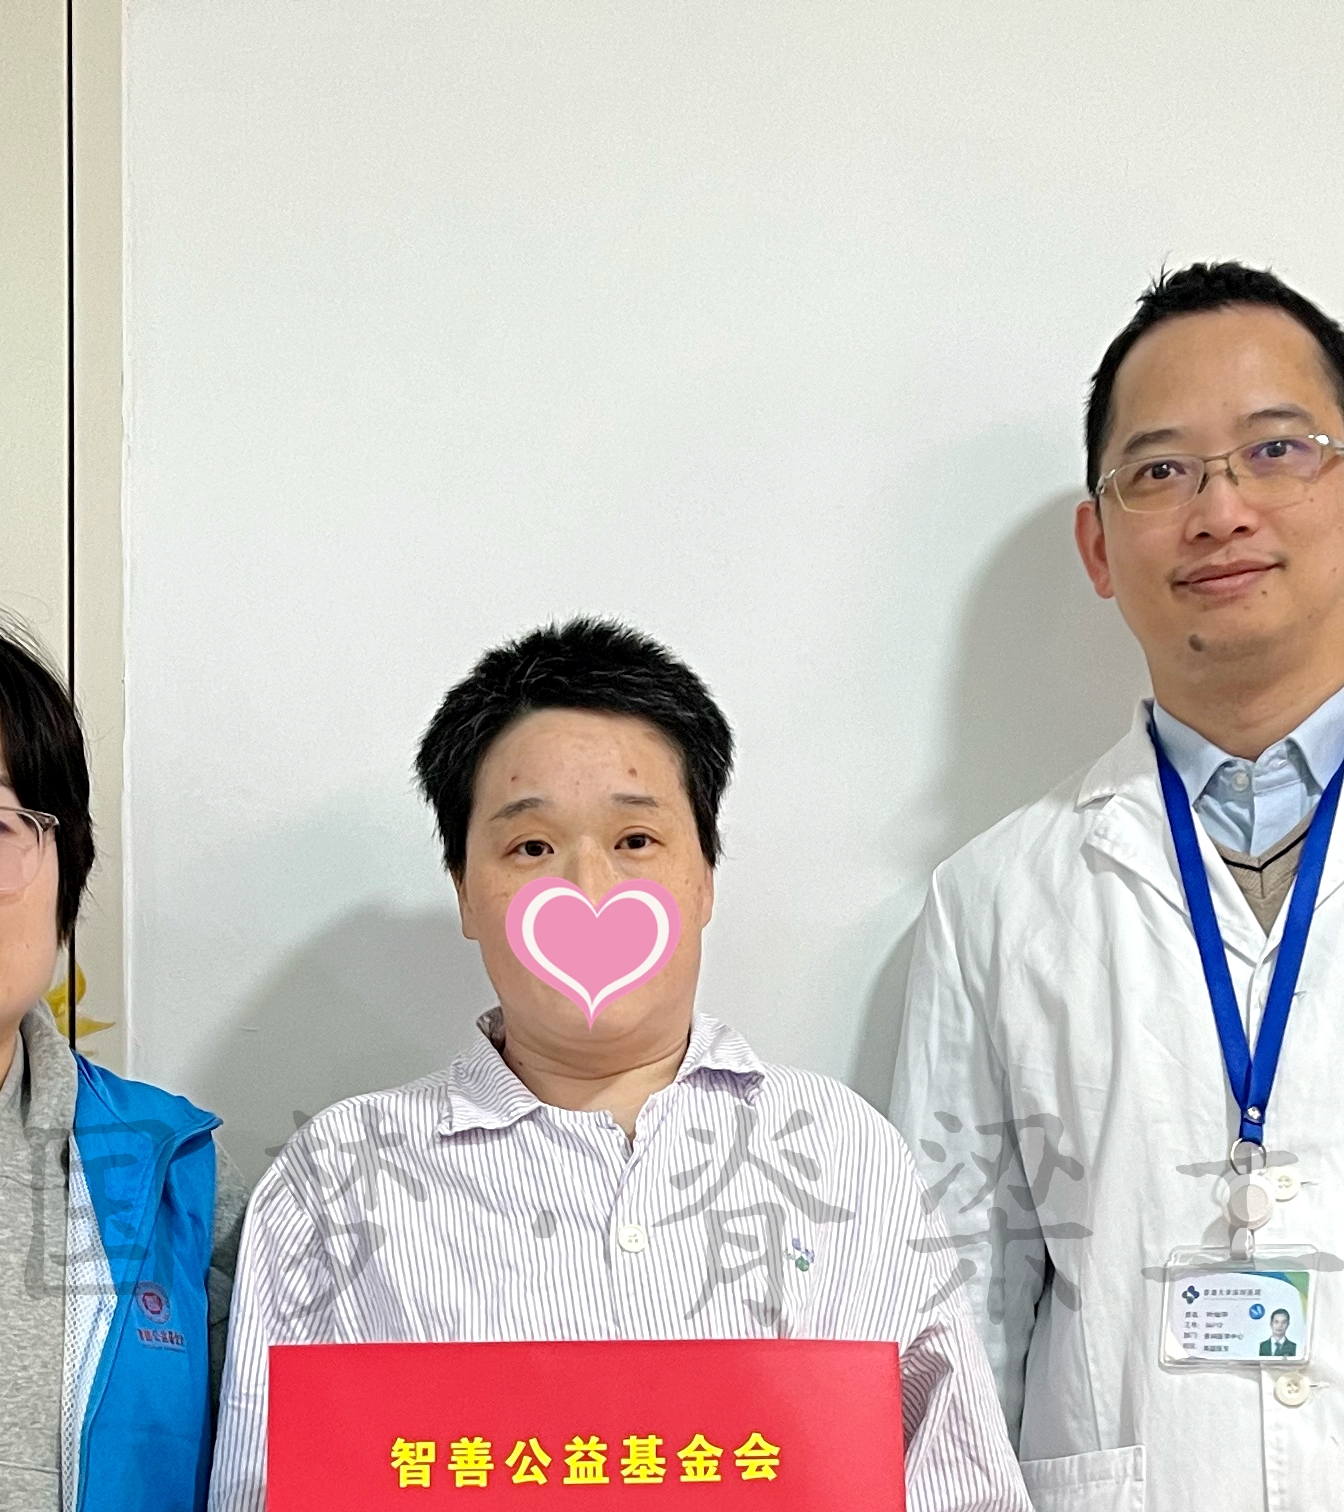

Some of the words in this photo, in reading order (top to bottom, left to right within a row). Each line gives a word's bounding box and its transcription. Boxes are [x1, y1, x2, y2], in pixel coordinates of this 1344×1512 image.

[391, 1432, 781, 1488] 智善公益基金会
